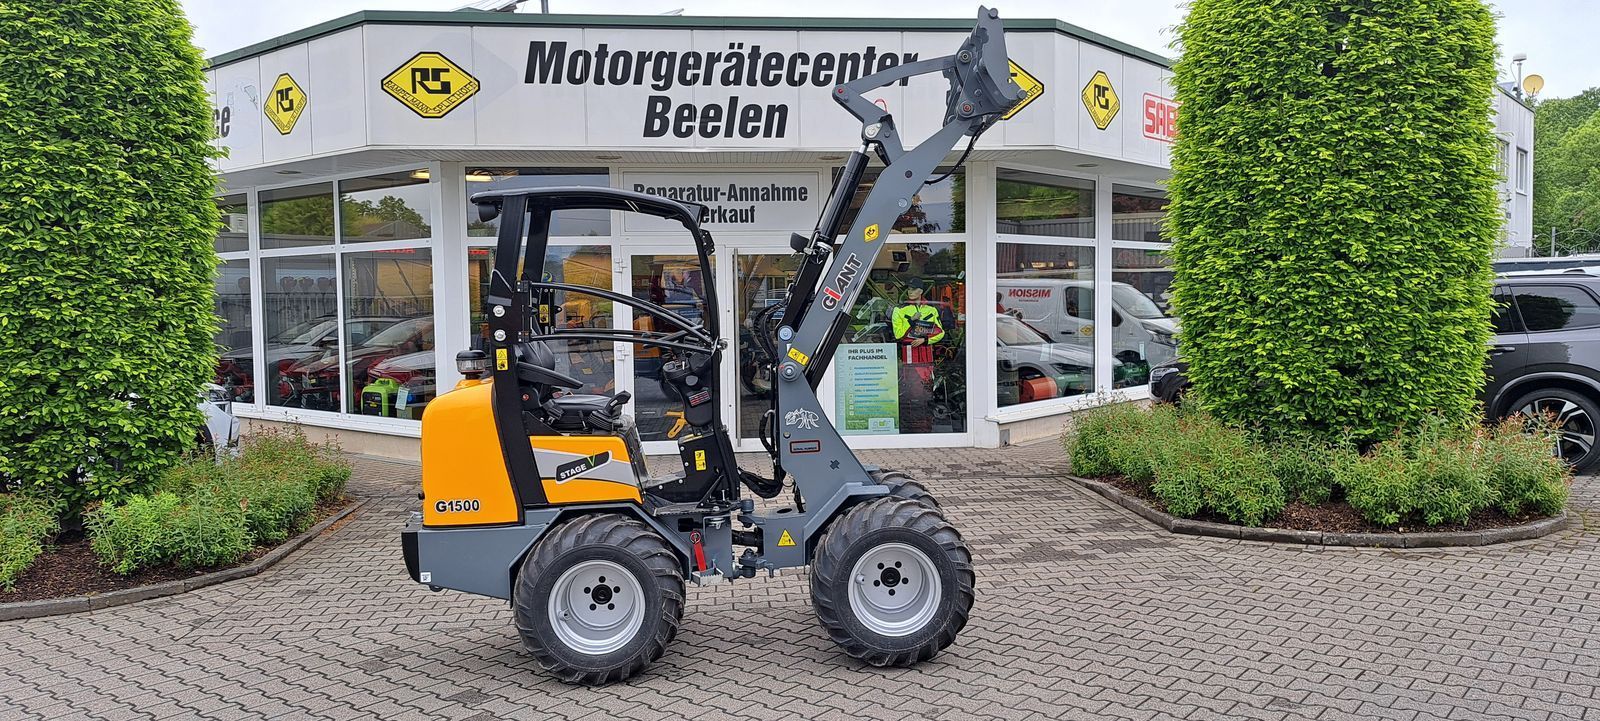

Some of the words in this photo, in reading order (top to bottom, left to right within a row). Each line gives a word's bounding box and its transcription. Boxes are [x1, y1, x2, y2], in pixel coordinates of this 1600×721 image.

[524, 41, 918, 90] Motorgerätecenter
[411, 67, 451, 94] RS
[642, 95, 788, 139] Beelen
[701, 205, 755, 223] erkauf
[560, 463, 587, 479] STAGE
[435, 499, 480, 513] G1500
